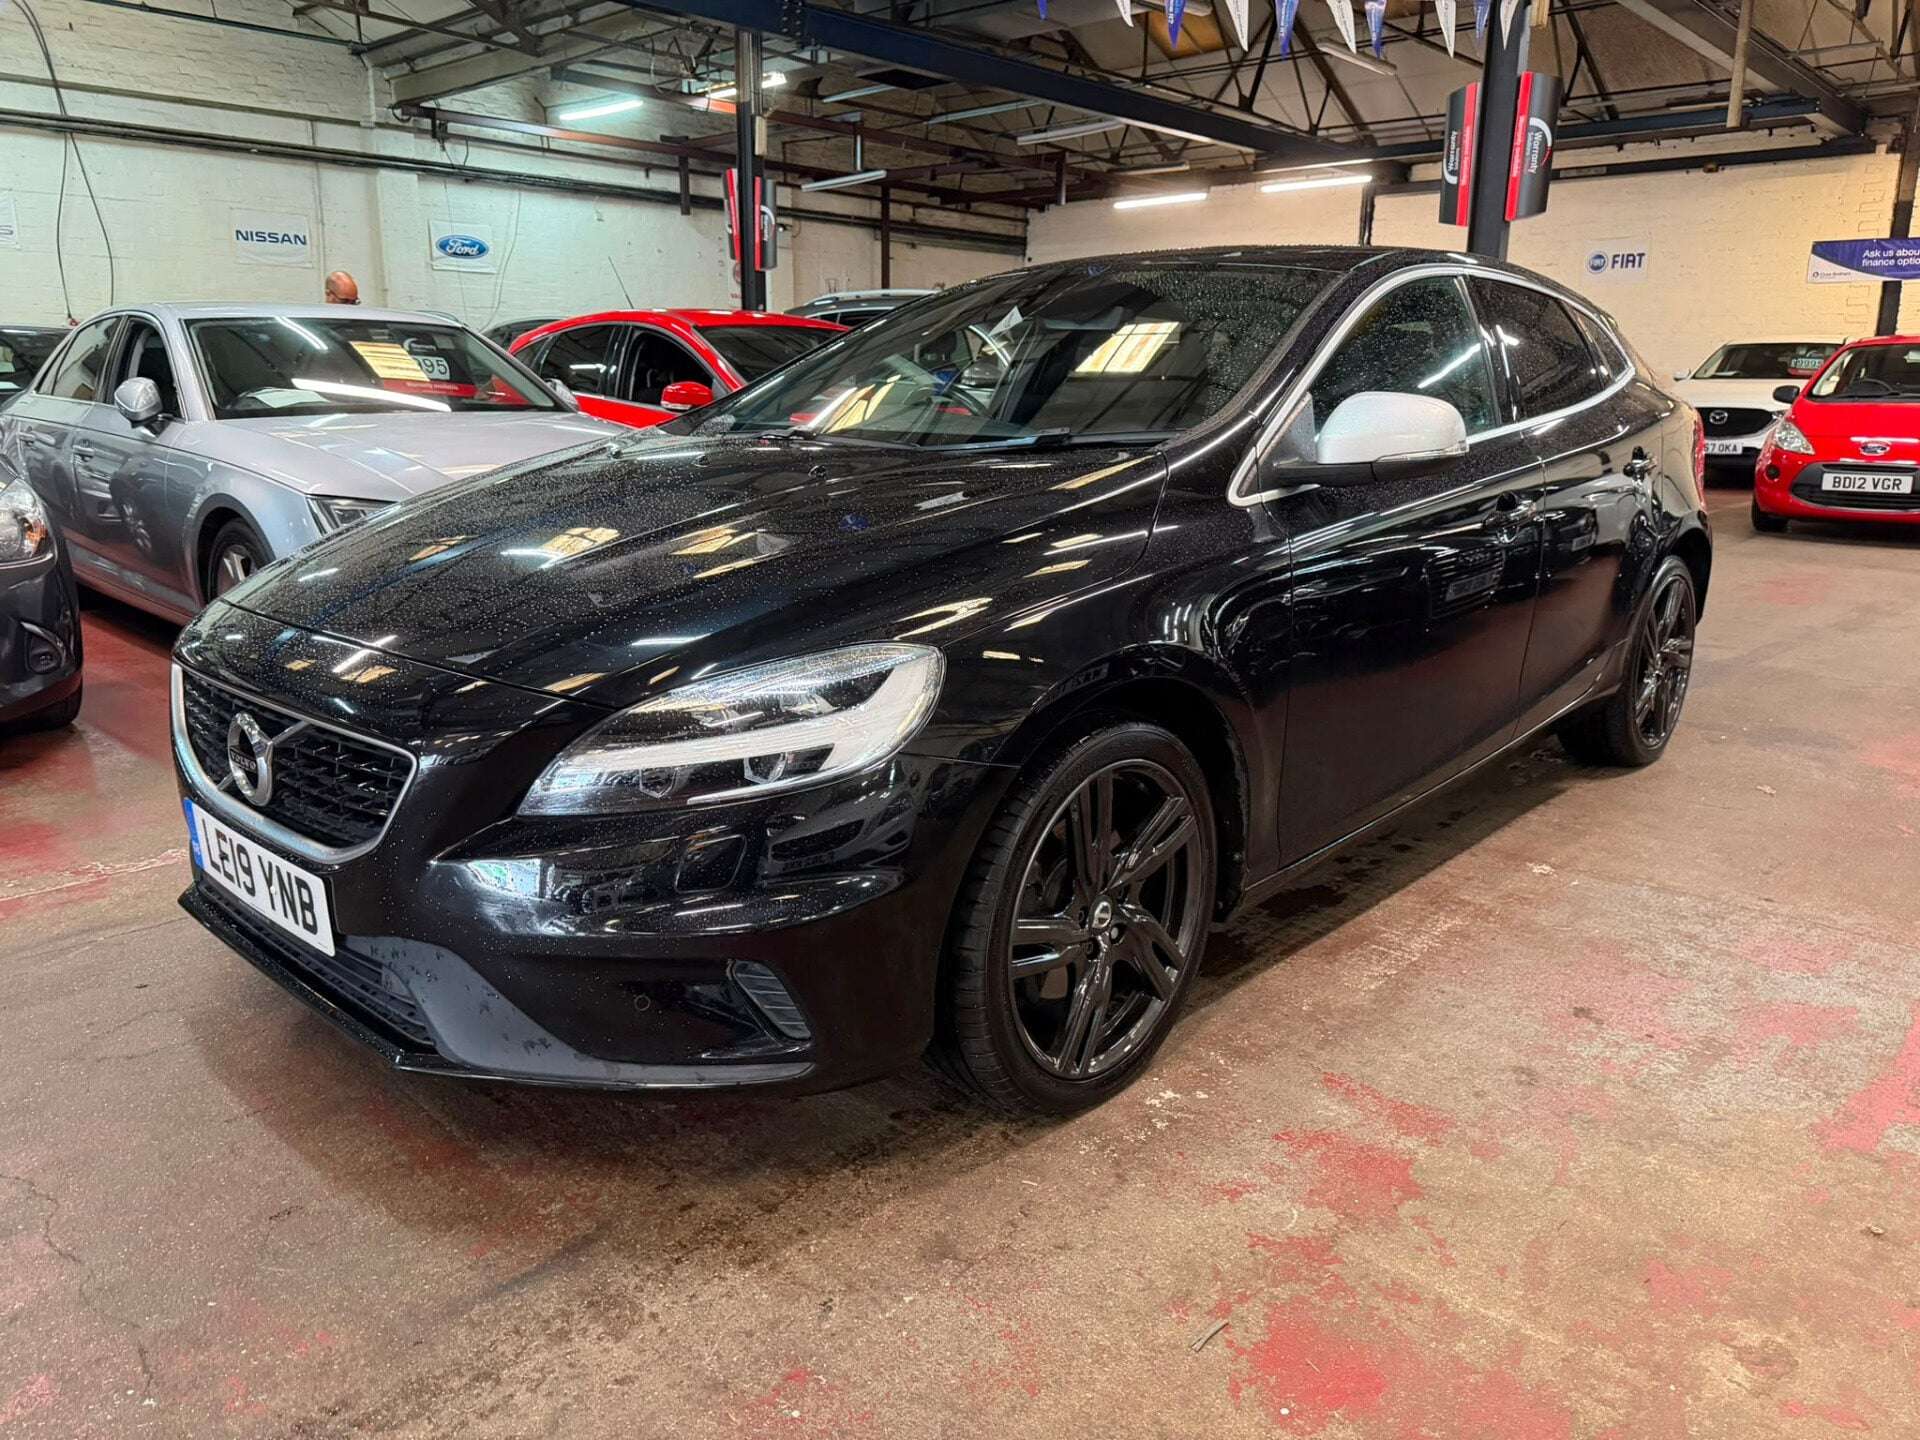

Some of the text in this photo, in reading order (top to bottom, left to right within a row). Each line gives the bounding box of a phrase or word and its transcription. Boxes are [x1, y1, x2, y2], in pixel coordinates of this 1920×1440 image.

[1528, 131, 1543, 174] Warranty
[235, 229, 307, 246] NISSAN
[445, 238, 480, 257] Ford
[1862, 249, 1881, 258] Ask
[1611, 252, 1646, 269] FIAT
[1862, 258, 1895, 267] finance
[1832, 475, 1903, 491] BD12 VGR
[230, 750, 257, 769] VOLVO
[202, 818, 318, 935] LE19 YNB
